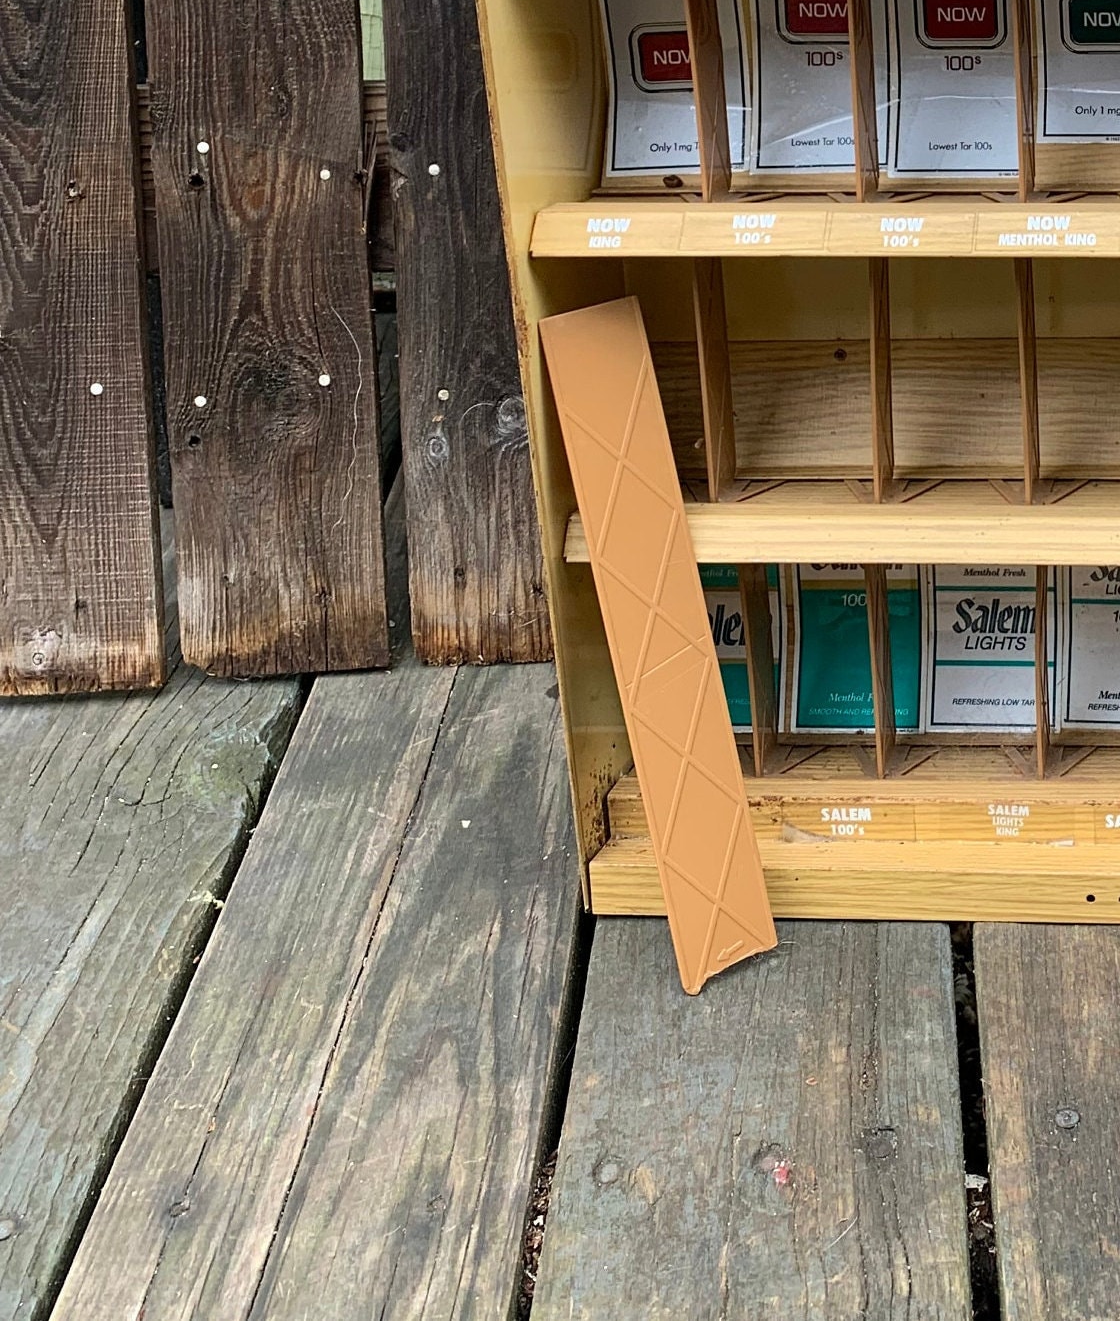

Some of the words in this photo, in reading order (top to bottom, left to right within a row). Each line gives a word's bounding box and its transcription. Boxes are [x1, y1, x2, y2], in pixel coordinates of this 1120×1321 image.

[799, 3, 848, 17] NOW
[937, 7, 986, 22] NOW
[1075, 106, 1097, 116] Only
[650, 142, 671, 153] Only
[791, 138, 820, 147] Lowest
[929, 142, 958, 151] Lowest
[960, 142, 972, 151] Tar
[974, 141, 992, 151] 100s
[587, 218, 631, 232] NOW
[733, 215, 776, 229] NOW
[881, 218, 924, 232] NOW
[1027, 216, 1071, 230] NOW
[589, 236, 621, 247] KING
[734, 232, 771, 244] 100's
[882, 235, 919, 247] 100's
[998, 234, 1059, 246] MENTHOL
[1065, 233, 1096, 245] KING
[964, 568, 1000, 577] Menthol
[1003, 568, 1026, 577] Fresh
[952, 598, 1035, 634] Salem
[964, 636, 1027, 650] LIGHTS
[829, 692, 865, 702] Menthol
[952, 698, 1000, 706] REFRESHING
[821, 807, 871, 821] SALEM
[988, 804, 1029, 816] SALEM
[992, 817, 1024, 827] LIGHTS
[830, 824, 864, 836] 100's
[995, 827, 1019, 836] KING
